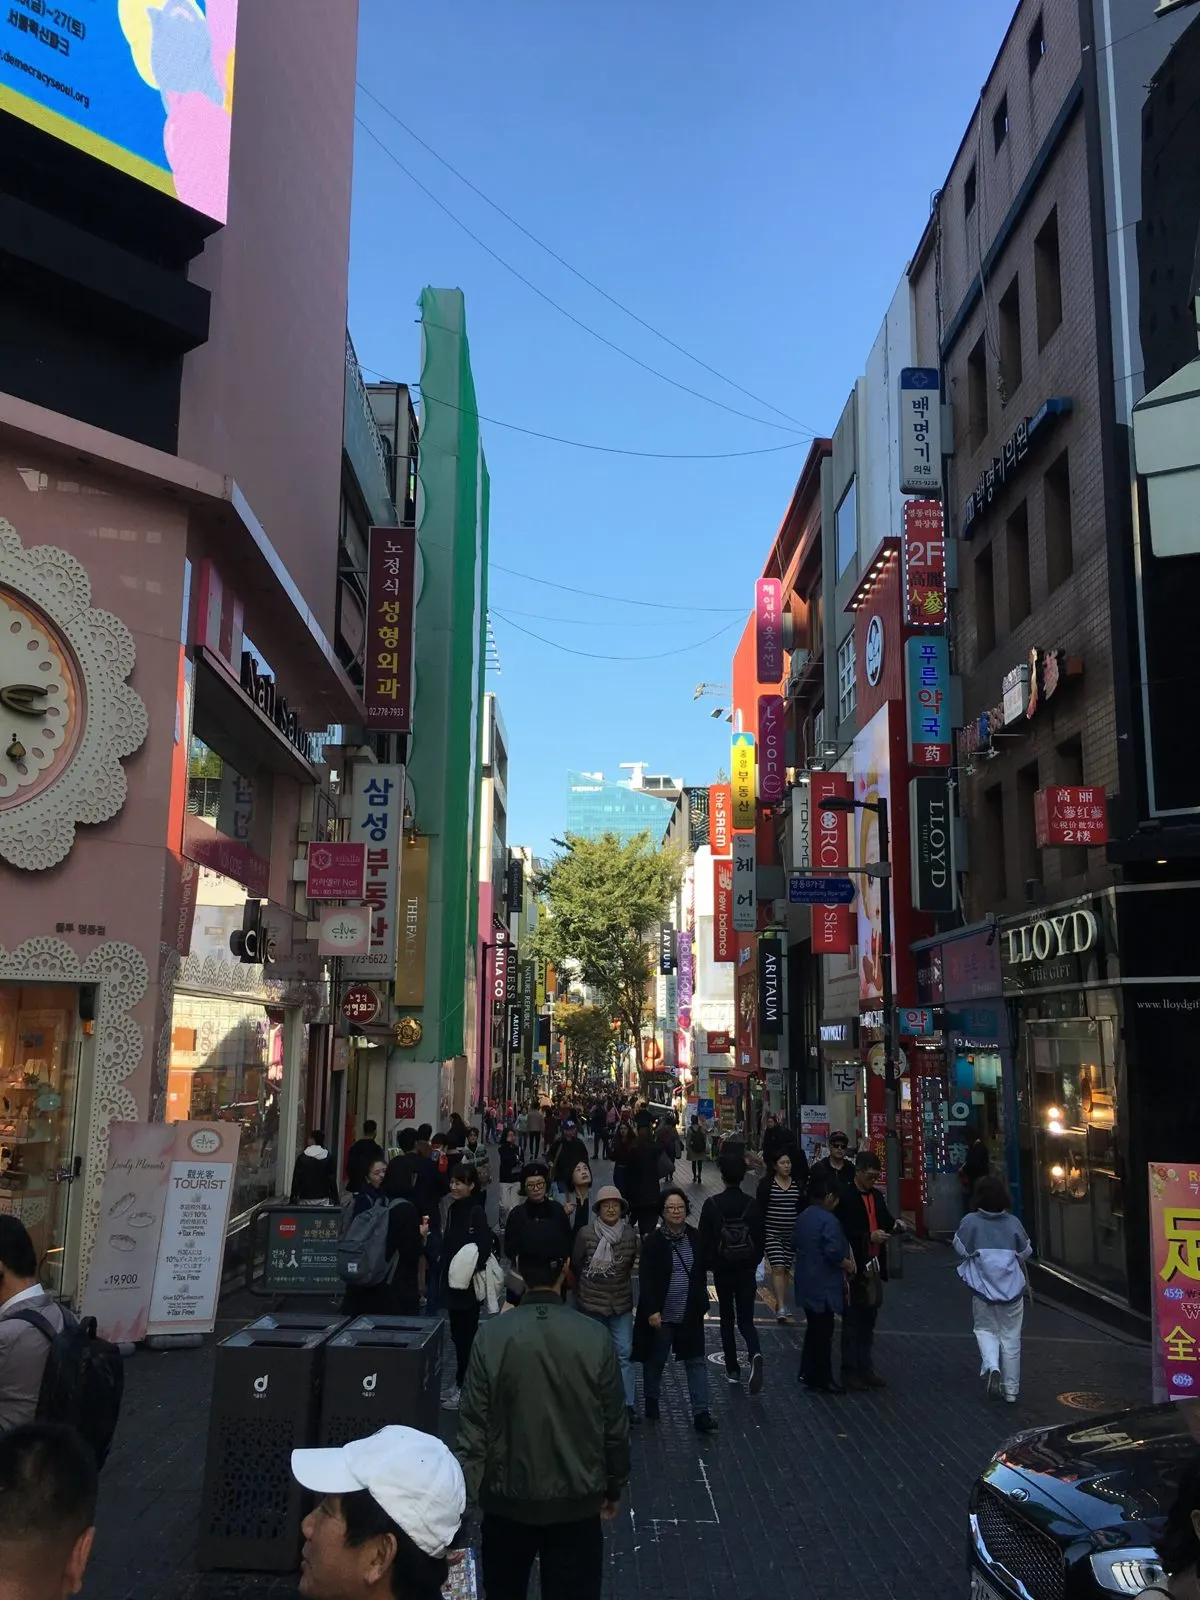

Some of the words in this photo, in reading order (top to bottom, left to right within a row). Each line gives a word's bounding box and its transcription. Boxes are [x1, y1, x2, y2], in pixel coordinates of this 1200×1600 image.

[0, 48, 90, 109] .democracyseoul.org
[912, 396, 929, 463] 백명기
[913, 465, 931, 475] 의원
[382, 541, 404, 596] 노정식
[909, 541, 942, 566] 2F
[376, 601, 400, 700] 성형외과
[918, 645, 943, 738] 푸른약국
[361, 778, 394, 842] 삼성
[715, 792, 725, 807] the
[738, 771, 750, 812] 부동산
[929, 800, 946, 888] LLOYD
[407, 897, 418, 922] THE
[719, 891, 728, 912] new
[719, 914, 729, 956] balance
[823, 912, 838, 943] Skin
[1008, 910, 1097, 965] LLOYD
[663, 929, 671, 969] JAYJUN
[494, 979, 504, 997] CO
[507, 955, 516, 999] GUESS
[765, 952, 778, 1021] ARITAUM
[512, 1013, 522, 1048] ARITAUM
[906, 1010, 927, 1034] 약
[399, 1097, 413, 1109] 50
[173, 1178, 226, 1190] TOURIST
